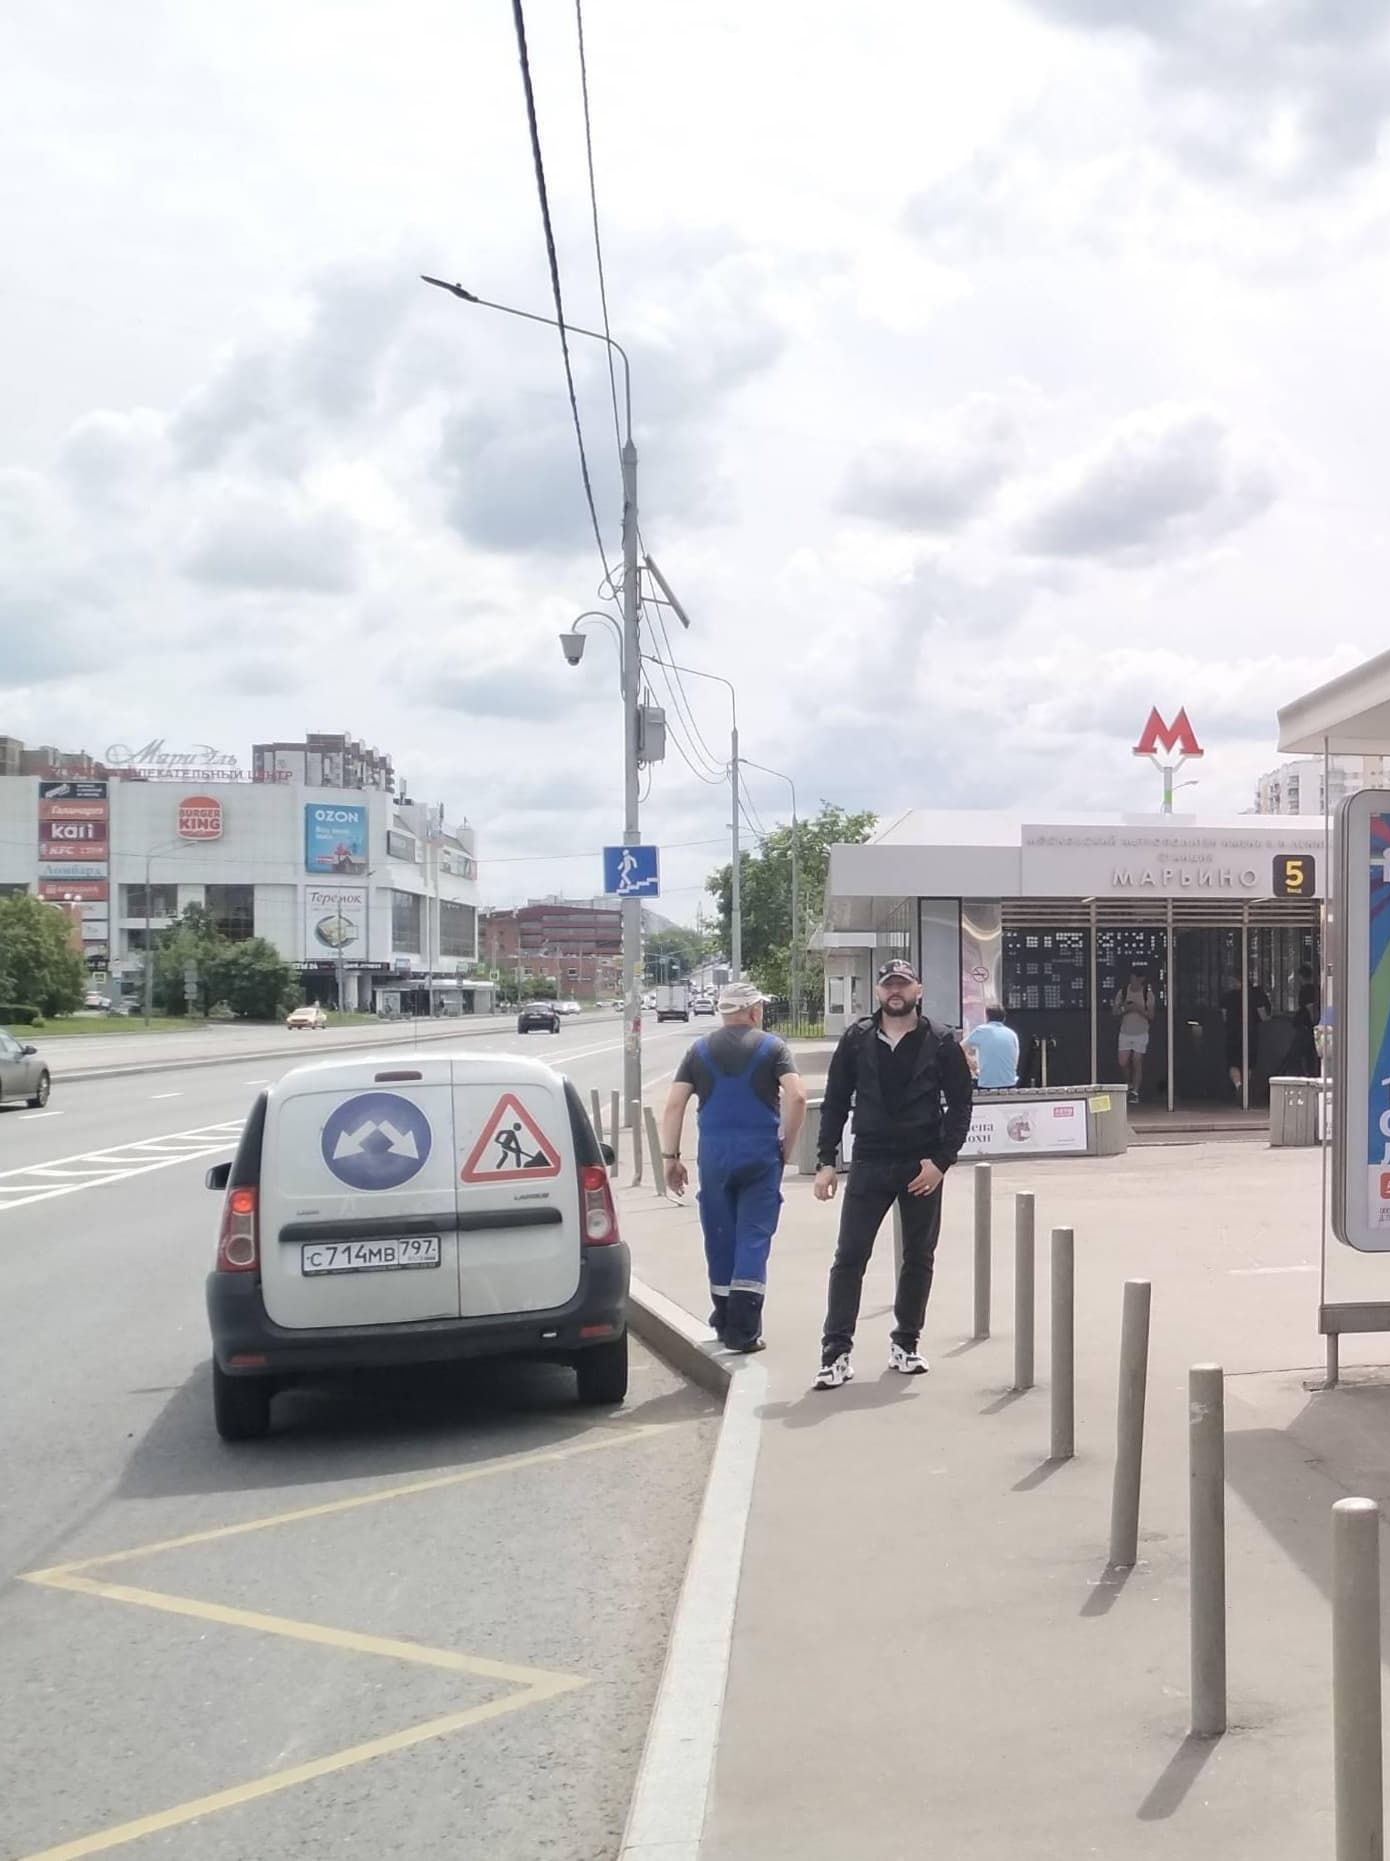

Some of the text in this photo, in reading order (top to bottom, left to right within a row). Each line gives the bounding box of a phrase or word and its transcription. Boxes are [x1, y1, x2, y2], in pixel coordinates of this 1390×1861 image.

[179, 809, 220, 818] BURGER
[52, 823, 93, 838] kari
[179, 818, 220, 831] KING
[1112, 869, 1258, 888] МАРЬИНО
[1285, 861, 1304, 886] 5
[310, 891, 362, 906] Теремок
[970, 1123, 994, 1133] ена
[967, 1135, 991, 1143] охи
[310, 1240, 433, 1267] С714МВ 797
